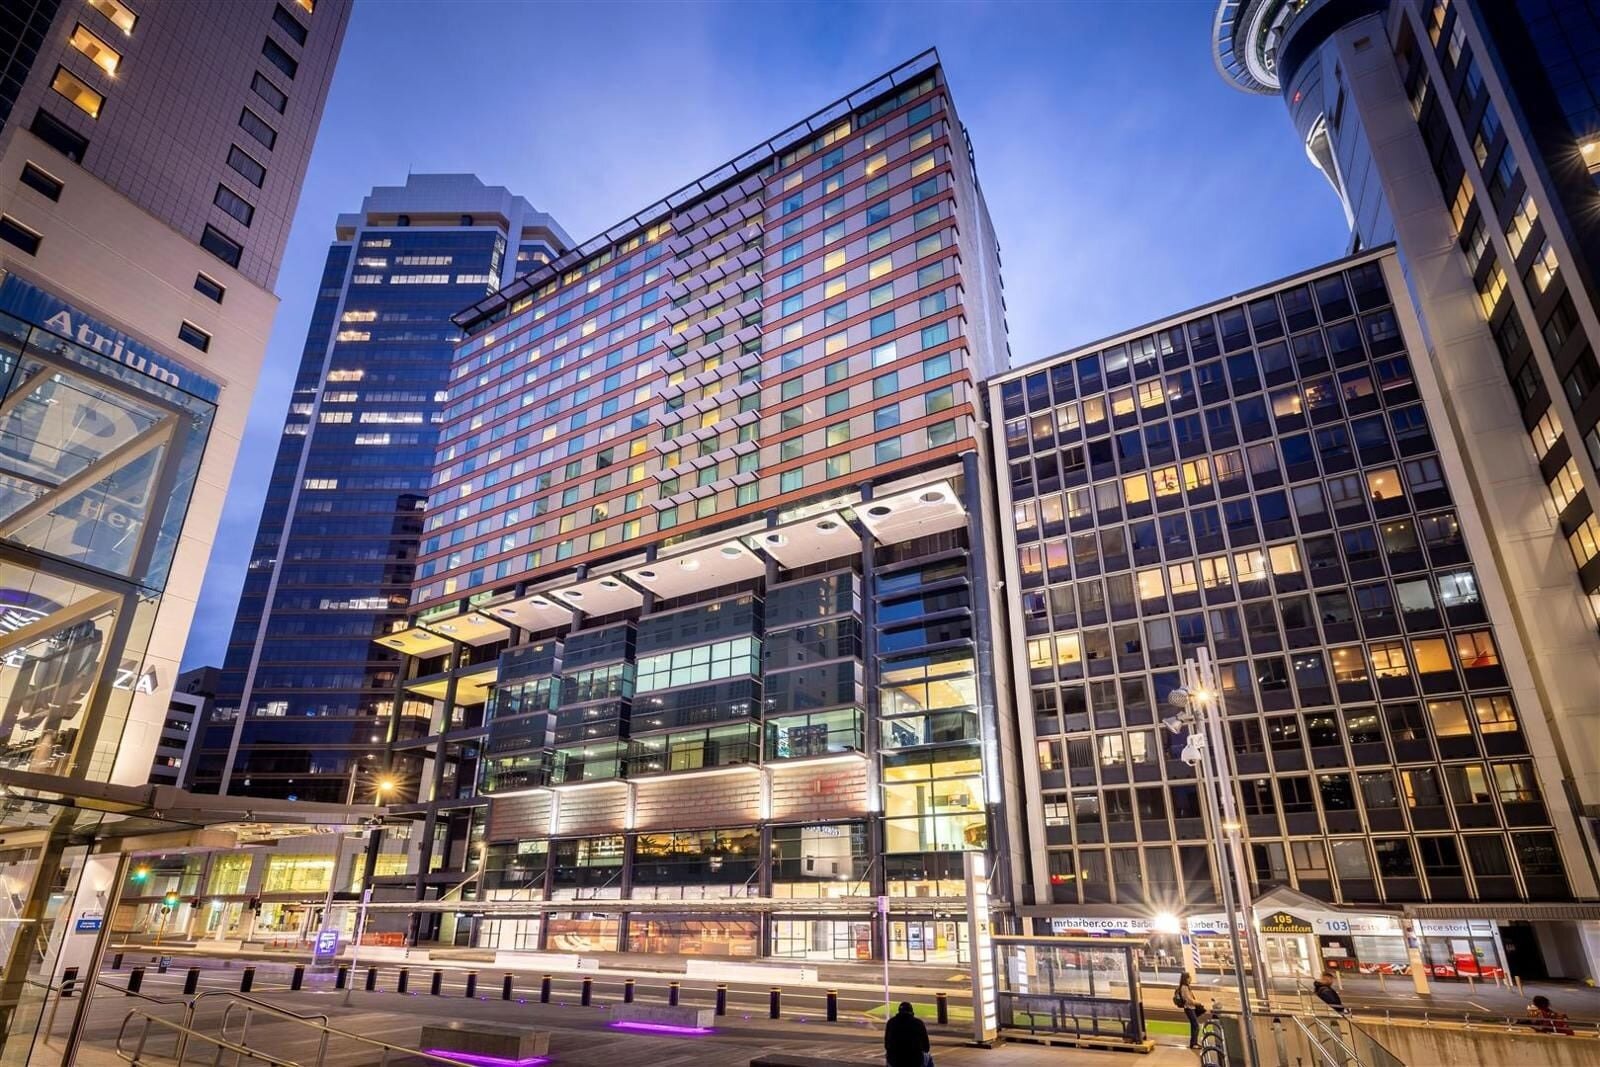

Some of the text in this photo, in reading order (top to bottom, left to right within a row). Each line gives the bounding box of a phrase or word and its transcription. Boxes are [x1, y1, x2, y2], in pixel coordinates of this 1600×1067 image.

[45, 310, 181, 387] Atrium
[1054, 919, 1128, 928] mrbarber.co.nz
[1273, 915, 1293, 924] 105
[1326, 920, 1348, 931] 103
